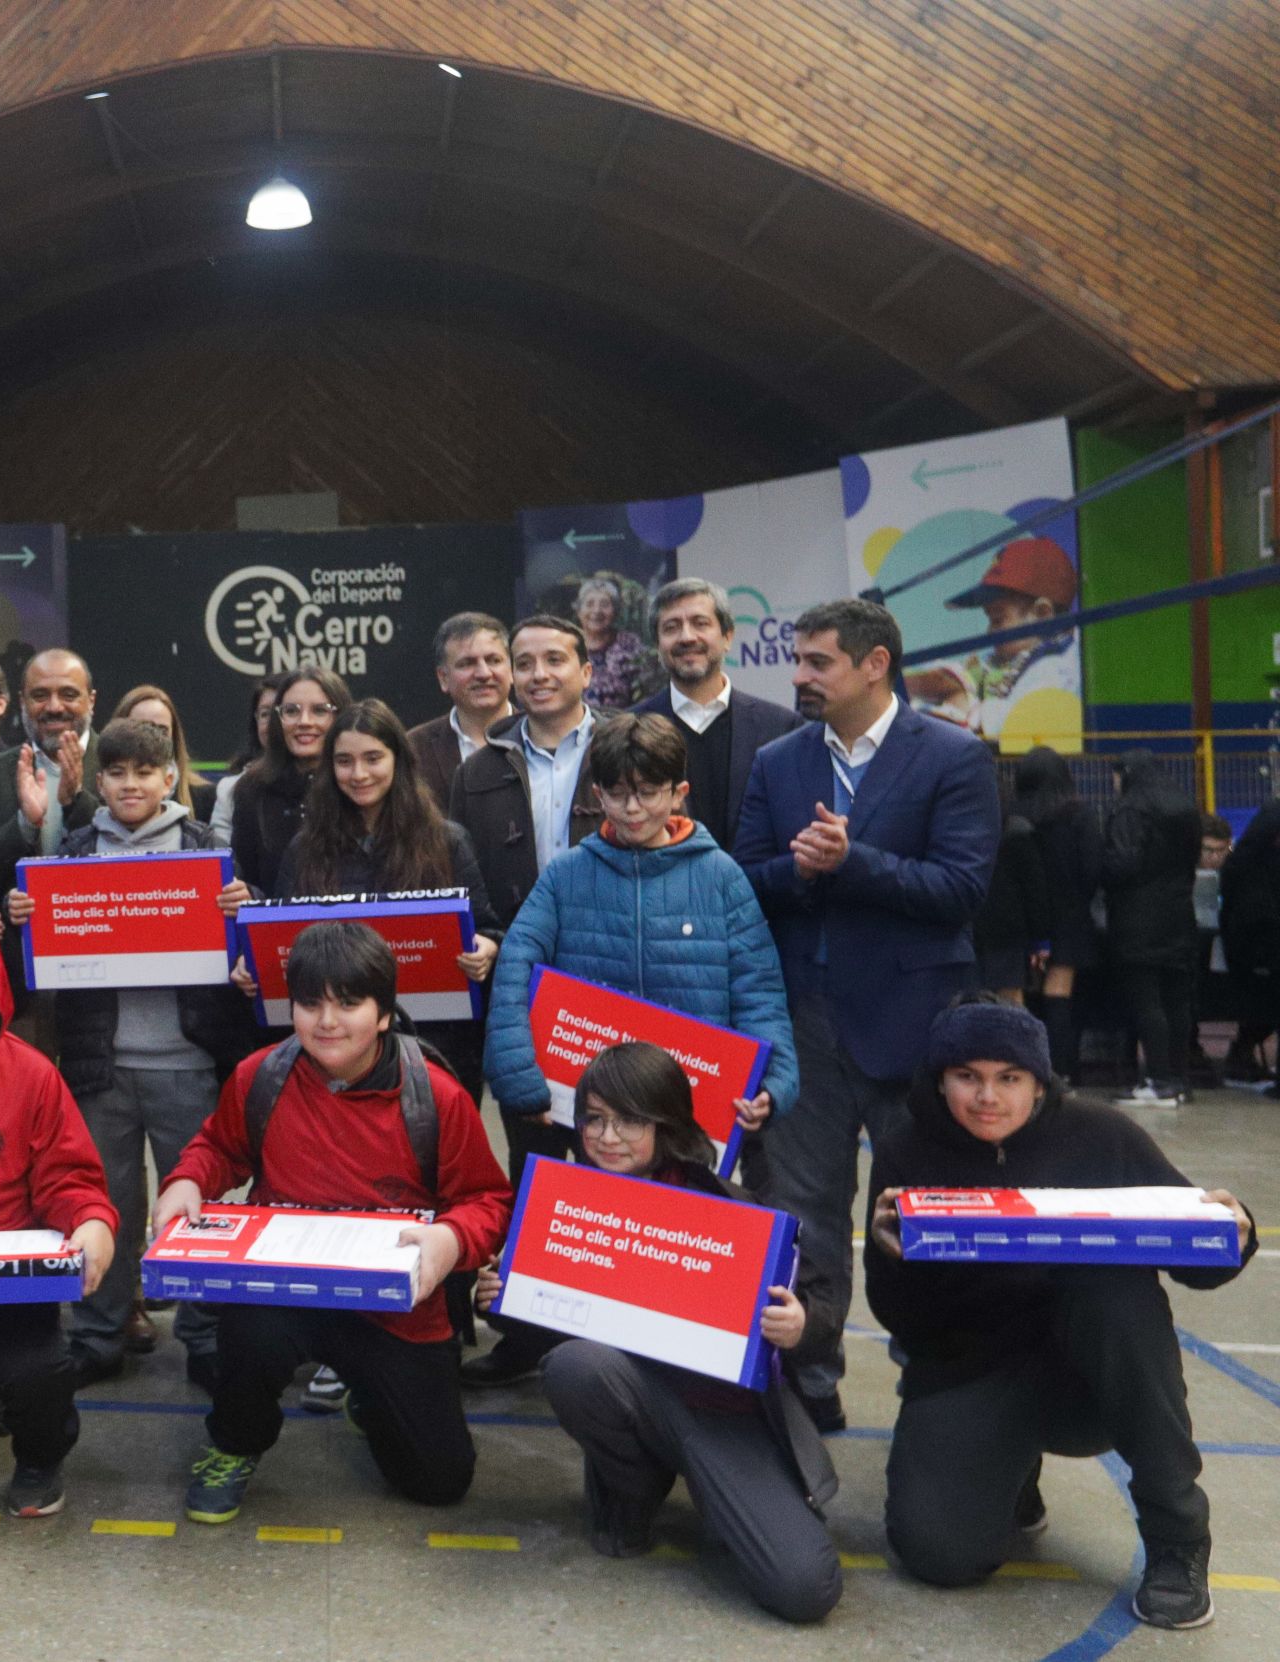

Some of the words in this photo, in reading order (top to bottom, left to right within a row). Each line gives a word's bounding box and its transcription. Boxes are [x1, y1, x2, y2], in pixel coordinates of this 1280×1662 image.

[311, 562, 405, 585] Corporación
[312, 589, 335, 604] del
[340, 584, 402, 605] Deporte
[295, 603, 394, 646] Cerro
[272, 633, 366, 674] Navia
[52, 893, 107, 903] Enciende
[110, 892, 124, 902] tu
[126, 888, 199, 901] creatividad.
[53, 908, 81, 919] Dale
[83, 907, 105, 918] clic
[107, 906, 118, 917] al
[121, 906, 158, 916] futuro
[161, 905, 184, 917] que
[54, 923, 113, 935] imaginas.
[386, 939, 437, 949] tividad.
[397, 953, 422, 963] que
[551, 1025, 582, 1045] Dale
[557, 1008, 619, 1040] Enciende
[664, 1047, 720, 1076] tividad.
[554, 1200, 622, 1229] Enciende
[625, 1218, 640, 1233] tu
[644, 1223, 735, 1257] creatividad.
[544, 1238, 615, 1269] imaginas.
[550, 1220, 583, 1239] Dale
[586, 1229, 611, 1247] clic
[614, 1238, 629, 1251] al
[632, 1242, 678, 1264] futuro
[682, 1255, 711, 1272] que
